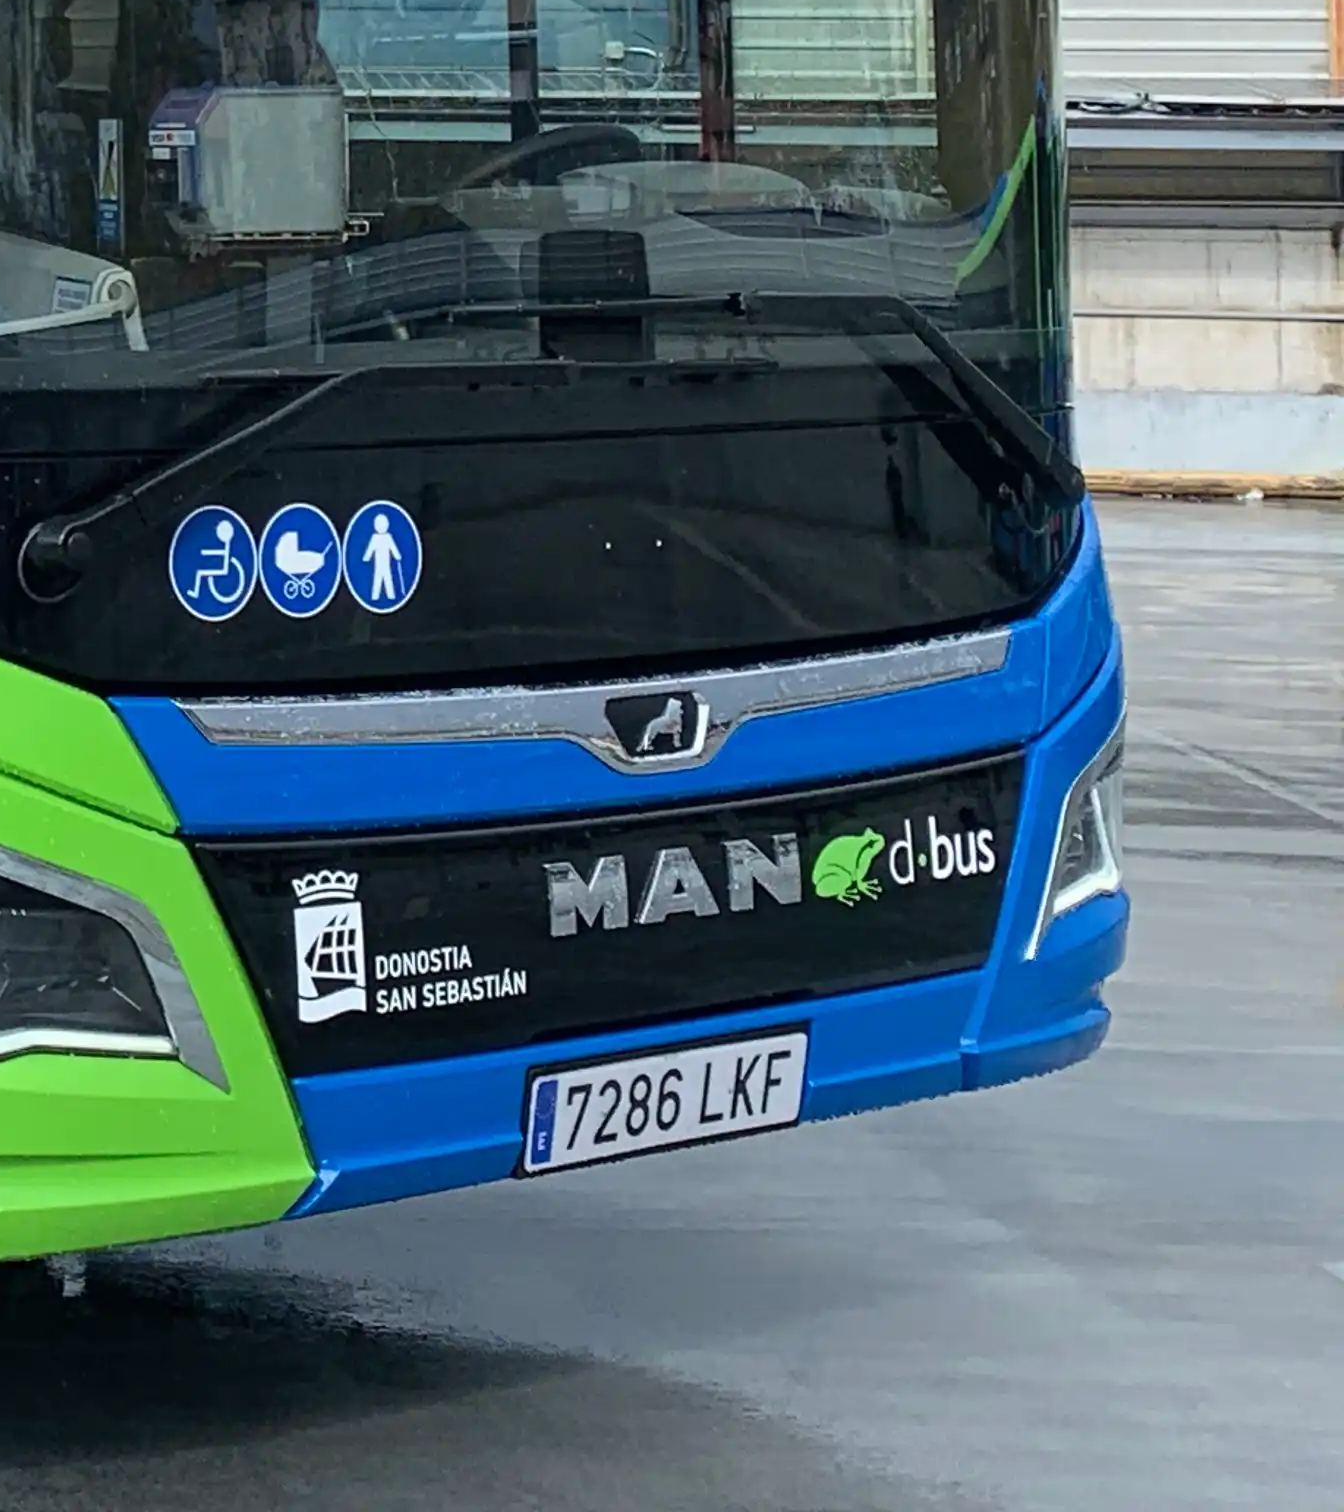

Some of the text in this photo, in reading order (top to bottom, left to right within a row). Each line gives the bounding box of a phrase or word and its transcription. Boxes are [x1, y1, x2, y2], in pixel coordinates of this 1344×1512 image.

[542, 833, 803, 938] MAN
[374, 943, 473, 981] DONOSTIA
[375, 968, 527, 1014] SAN SEBASTIÁN
[565, 1049, 792, 1151] 7286 LKF
